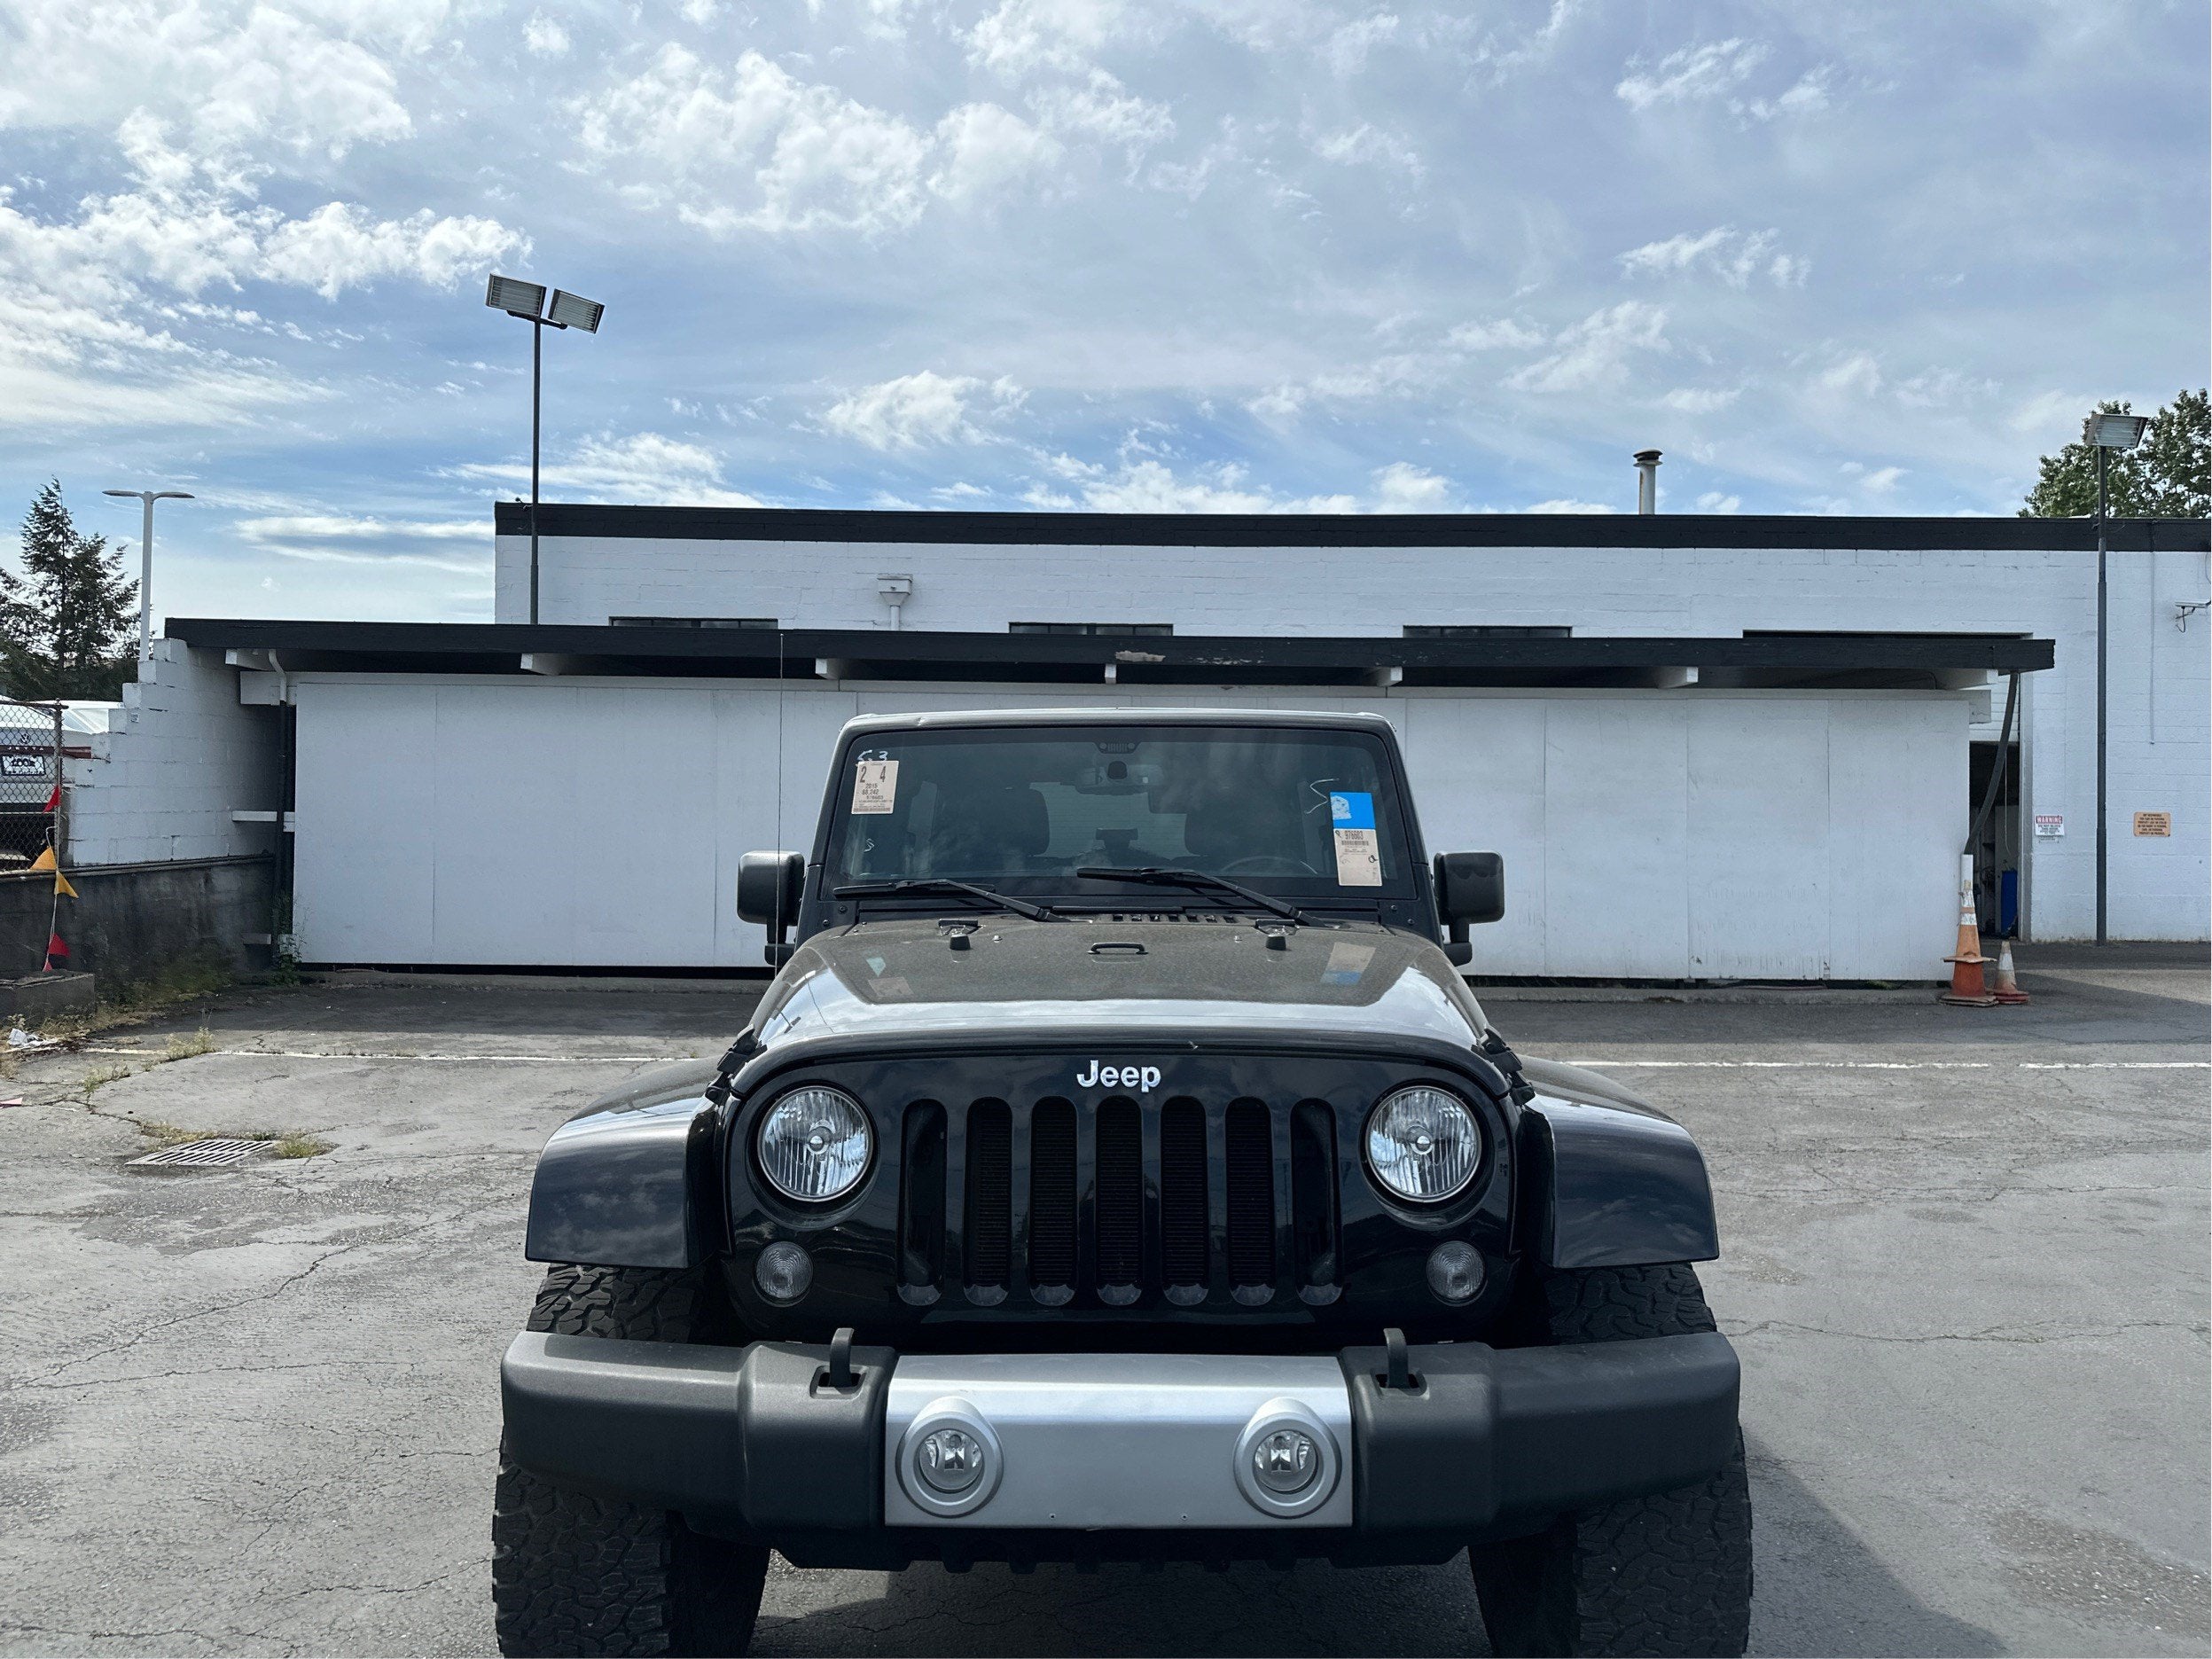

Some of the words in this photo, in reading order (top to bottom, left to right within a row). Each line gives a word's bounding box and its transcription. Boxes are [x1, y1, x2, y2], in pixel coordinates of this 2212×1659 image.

[859, 765, 867, 783] 2
[879, 765, 887, 783] 4
[1076, 1060, 1161, 1092] Jeep
